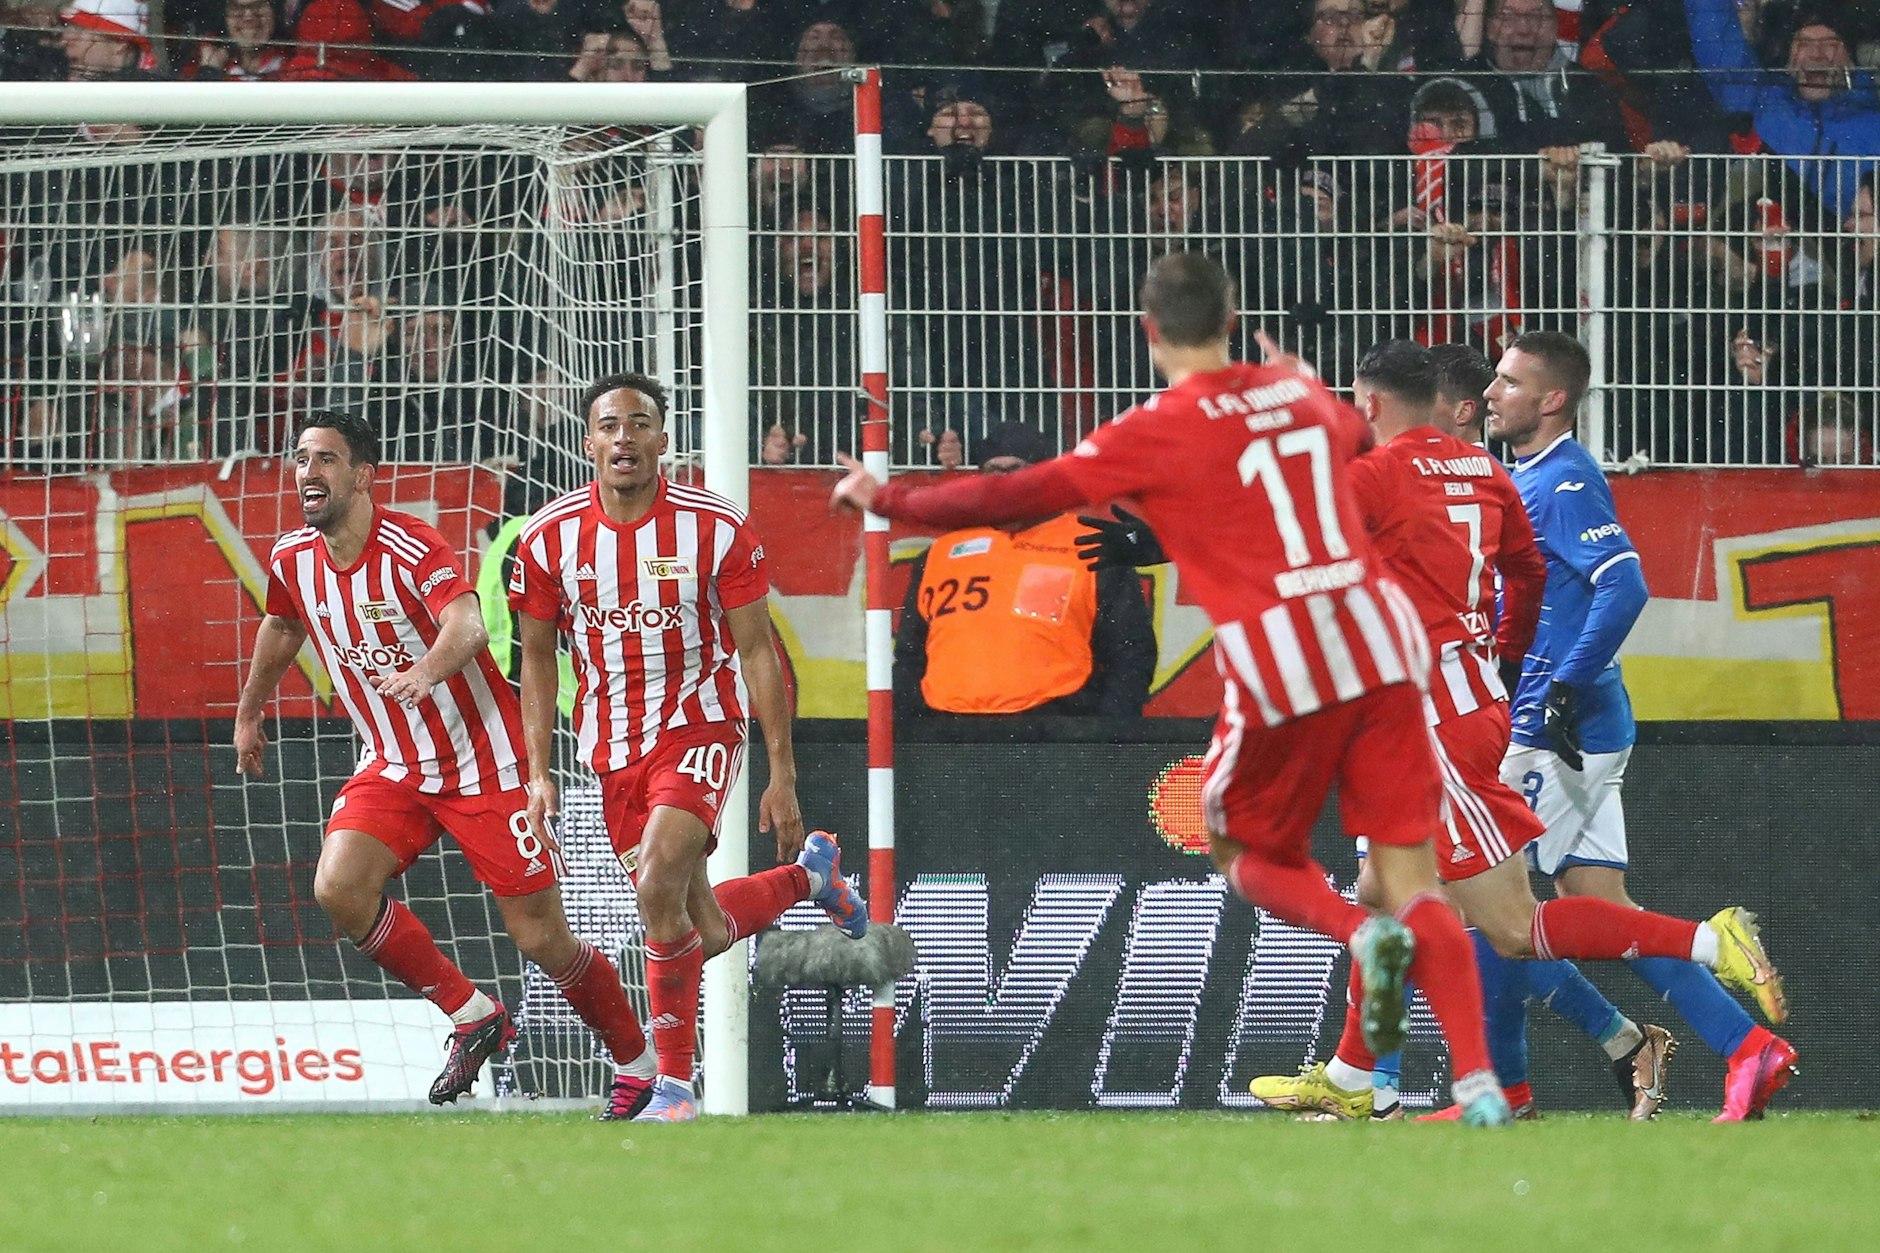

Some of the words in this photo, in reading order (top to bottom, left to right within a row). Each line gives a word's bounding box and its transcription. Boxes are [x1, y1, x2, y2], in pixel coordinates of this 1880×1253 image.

[1443, 456, 1493, 477] UNION
[1443, 481, 1475, 496] BERLIN
[1237, 425, 1350, 568] 17
[1446, 503, 1485, 611] 7
[579, 600, 686, 633] wefox
[676, 742, 728, 790] 40
[508, 810, 543, 859] 8
[0, 1036, 364, 1095] talEnergies
